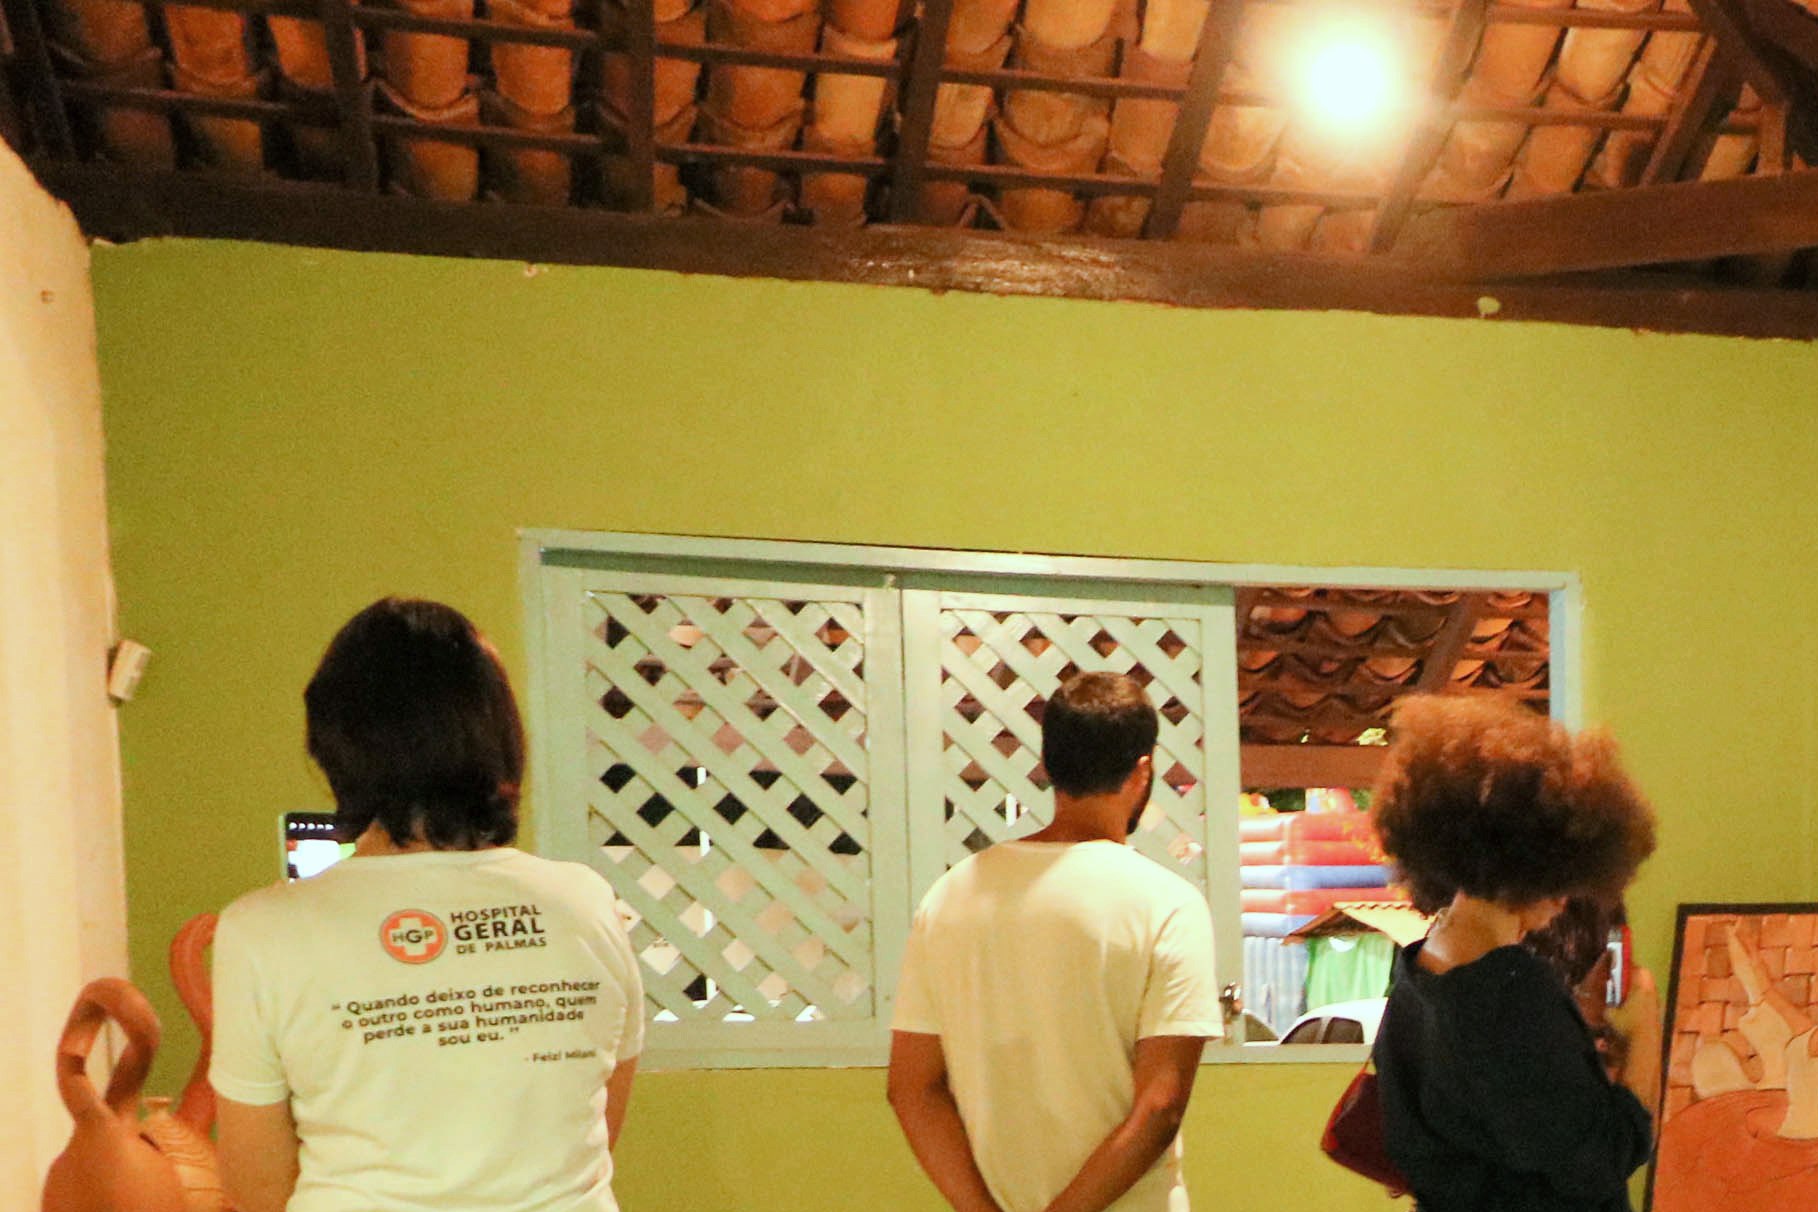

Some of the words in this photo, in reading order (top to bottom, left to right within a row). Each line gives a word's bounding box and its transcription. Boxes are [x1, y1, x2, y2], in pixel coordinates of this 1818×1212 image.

[451, 905, 542, 923] HOSPITAL
[392, 930, 434, 943] HGP
[454, 918, 545, 941] GERAL
[456, 944, 476, 954] DE
[485, 937, 547, 952] PALMAS
[347, 995, 420, 1016] Quando
[426, 988, 477, 1004] deixo
[483, 985, 504, 998] de
[511, 980, 600, 996] reconhecer
[342, 1019, 353, 1030] o
[358, 1012, 407, 1028] outro
[413, 1004, 464, 1020] como
[556, 995, 597, 1008] quem
[364, 1024, 415, 1045] perde
[422, 1023, 432, 1034] a
[438, 1019, 470, 1033] sua
[476, 1009, 585, 1028] humanidade
[438, 1034, 471, 1047] sou
